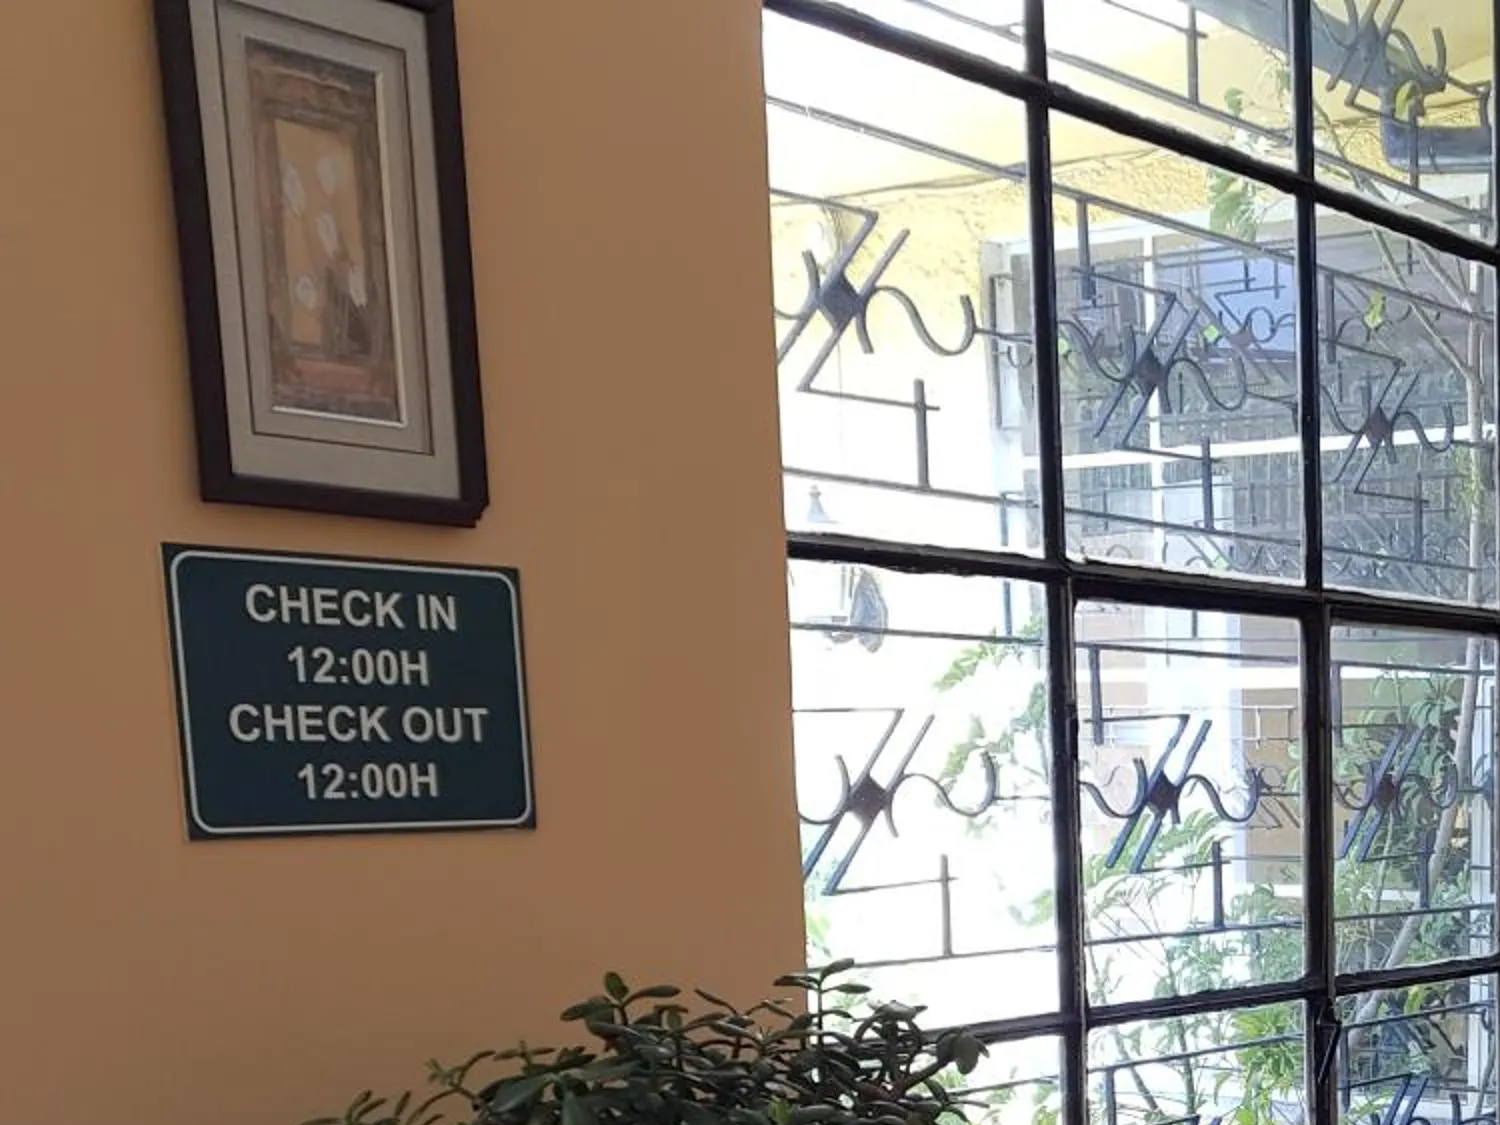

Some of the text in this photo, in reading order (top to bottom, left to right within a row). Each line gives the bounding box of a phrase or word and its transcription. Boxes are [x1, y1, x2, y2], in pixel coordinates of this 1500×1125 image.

[244, 583, 457, 631] CHECK IN
[287, 646, 429, 686] 12:00H
[228, 703, 489, 743] CHECK OUT
[297, 763, 439, 800] 12:00H
